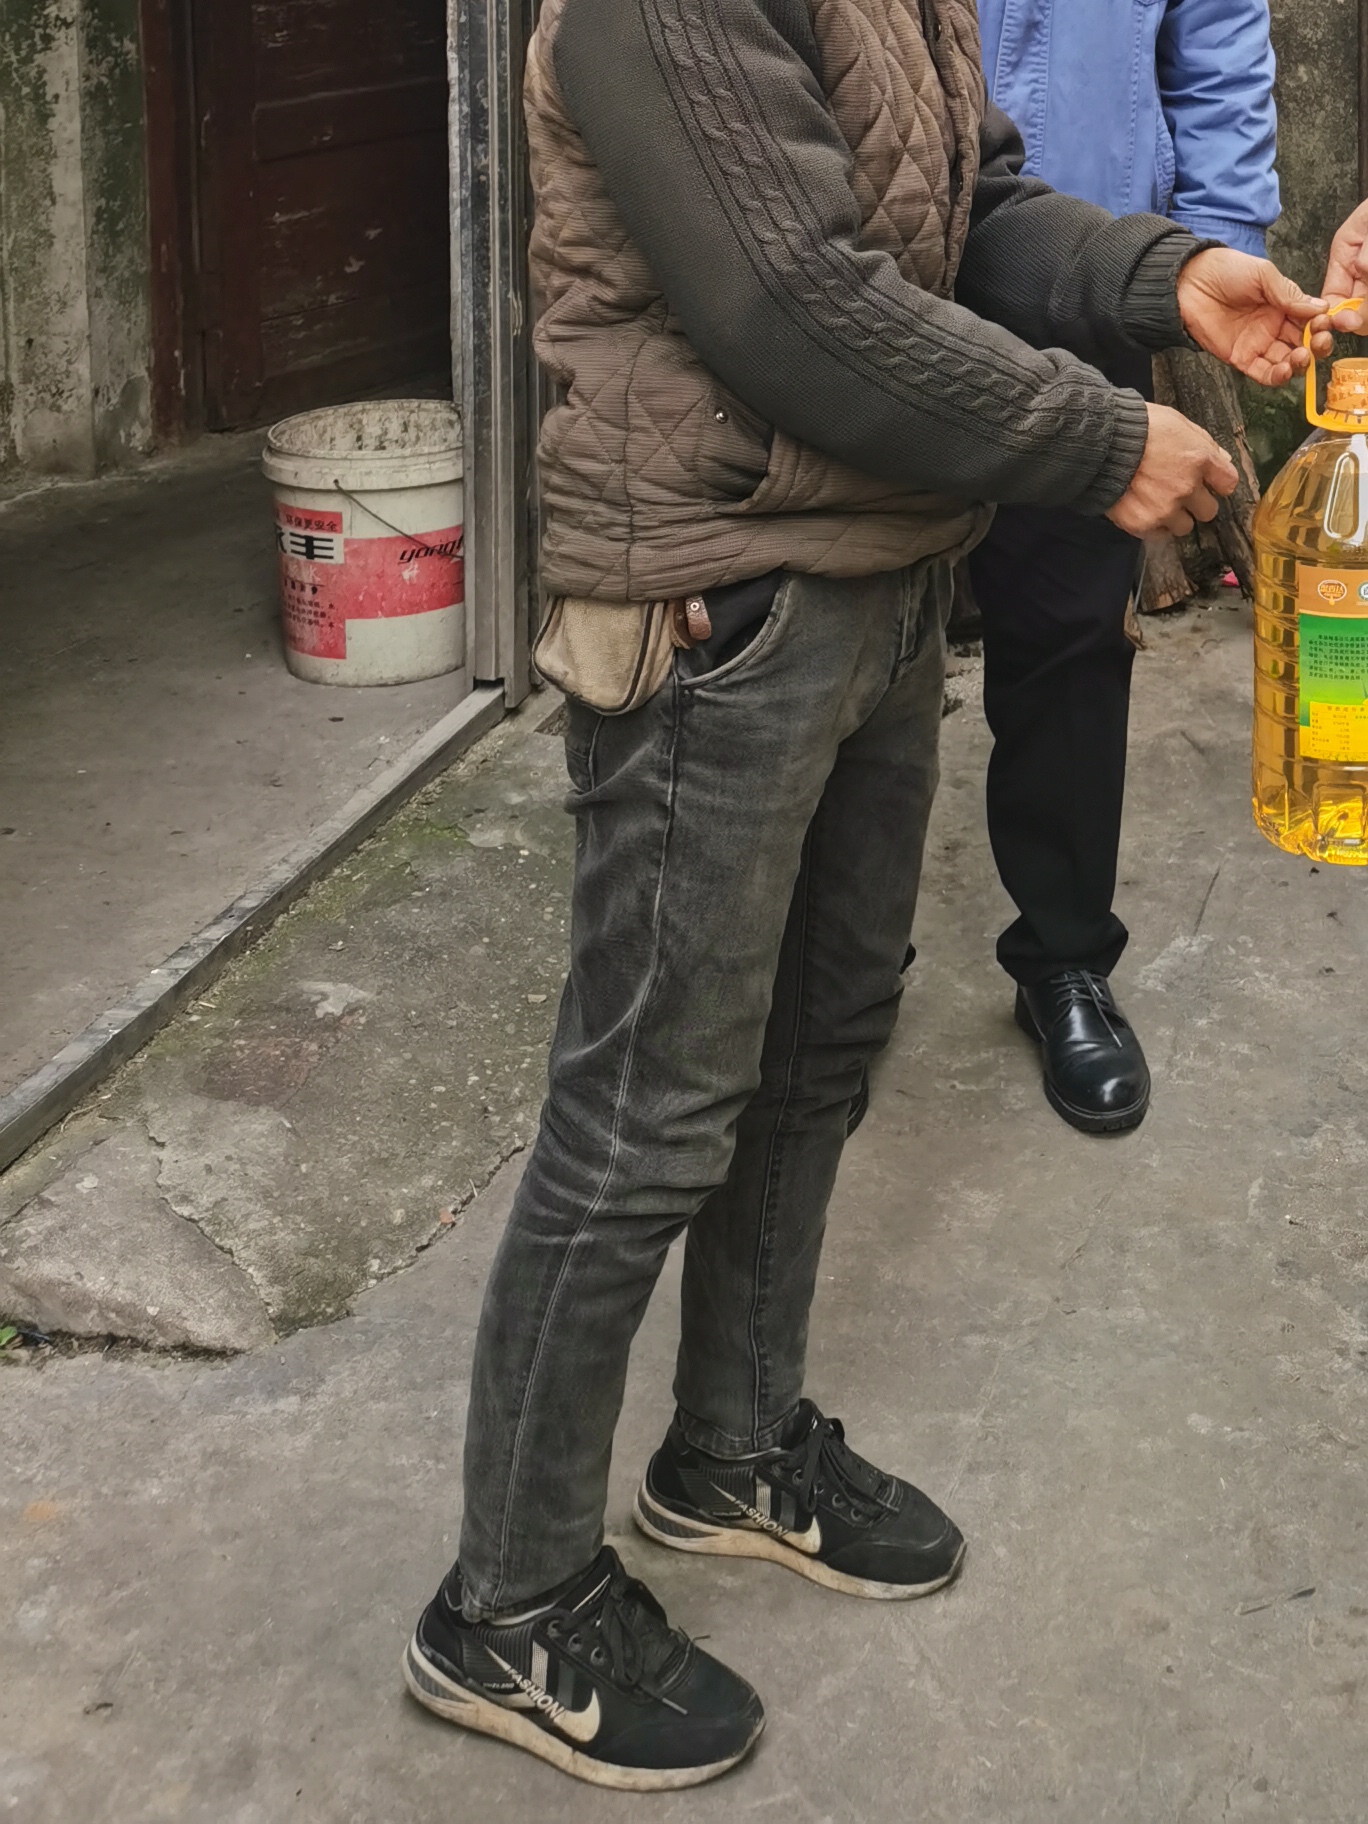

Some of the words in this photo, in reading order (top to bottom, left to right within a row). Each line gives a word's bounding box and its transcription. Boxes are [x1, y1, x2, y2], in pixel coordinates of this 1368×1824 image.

[398, 534, 464, 566] yong
[734, 1499, 789, 1537] FASHION
[507, 1668, 565, 1719] FASHION
